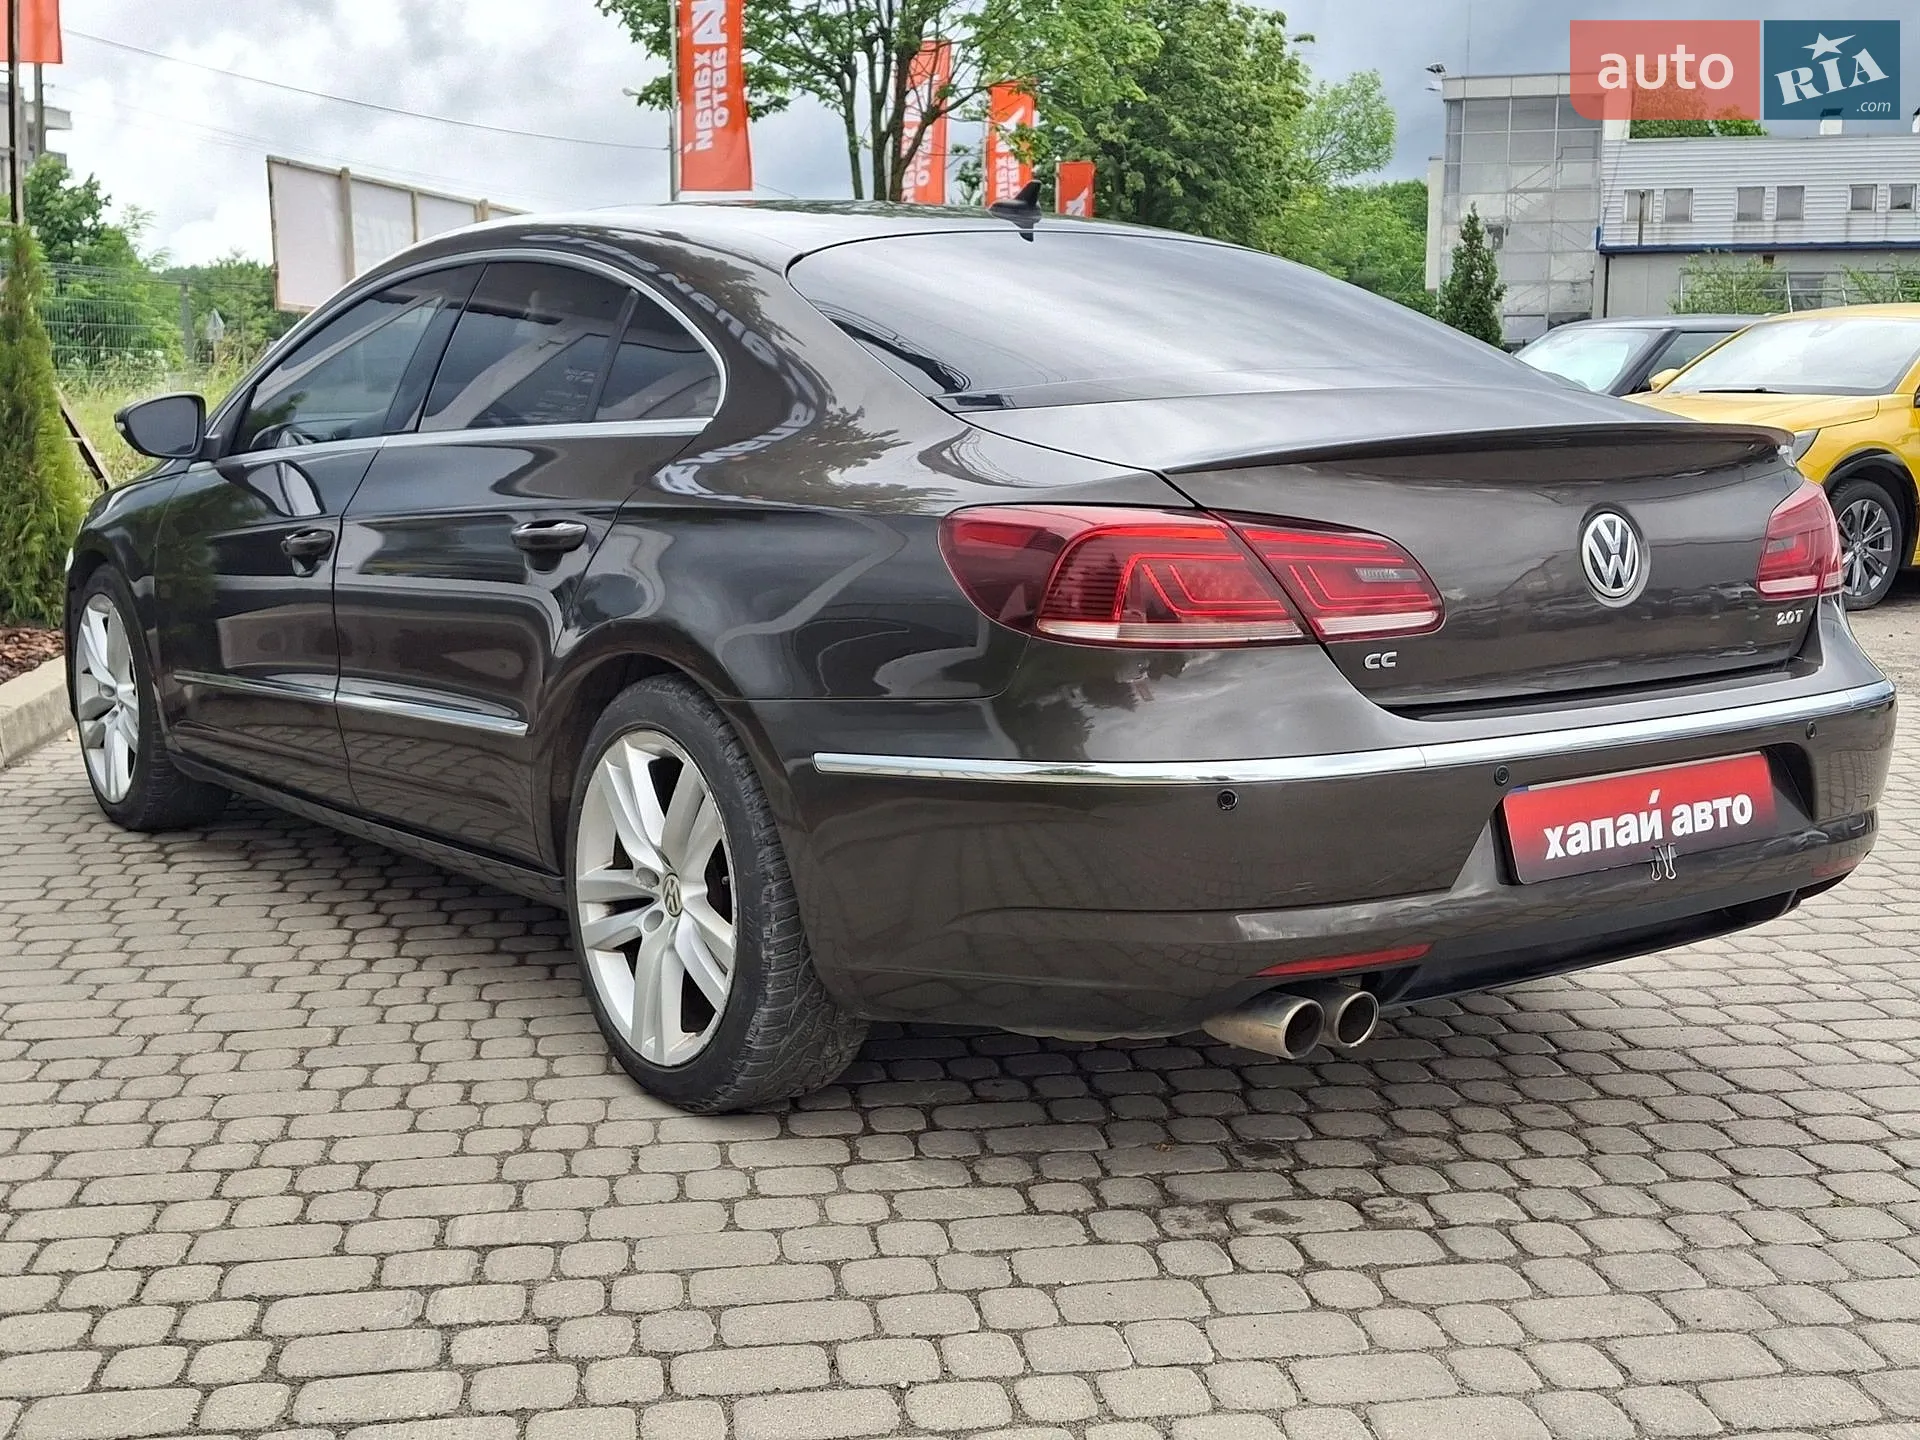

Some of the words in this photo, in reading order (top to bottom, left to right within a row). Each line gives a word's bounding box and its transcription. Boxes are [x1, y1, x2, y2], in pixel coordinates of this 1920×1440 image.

[1364, 651, 1397, 669] CC
[1543, 789, 1664, 860] хапай
[1671, 794, 1753, 837] авто
